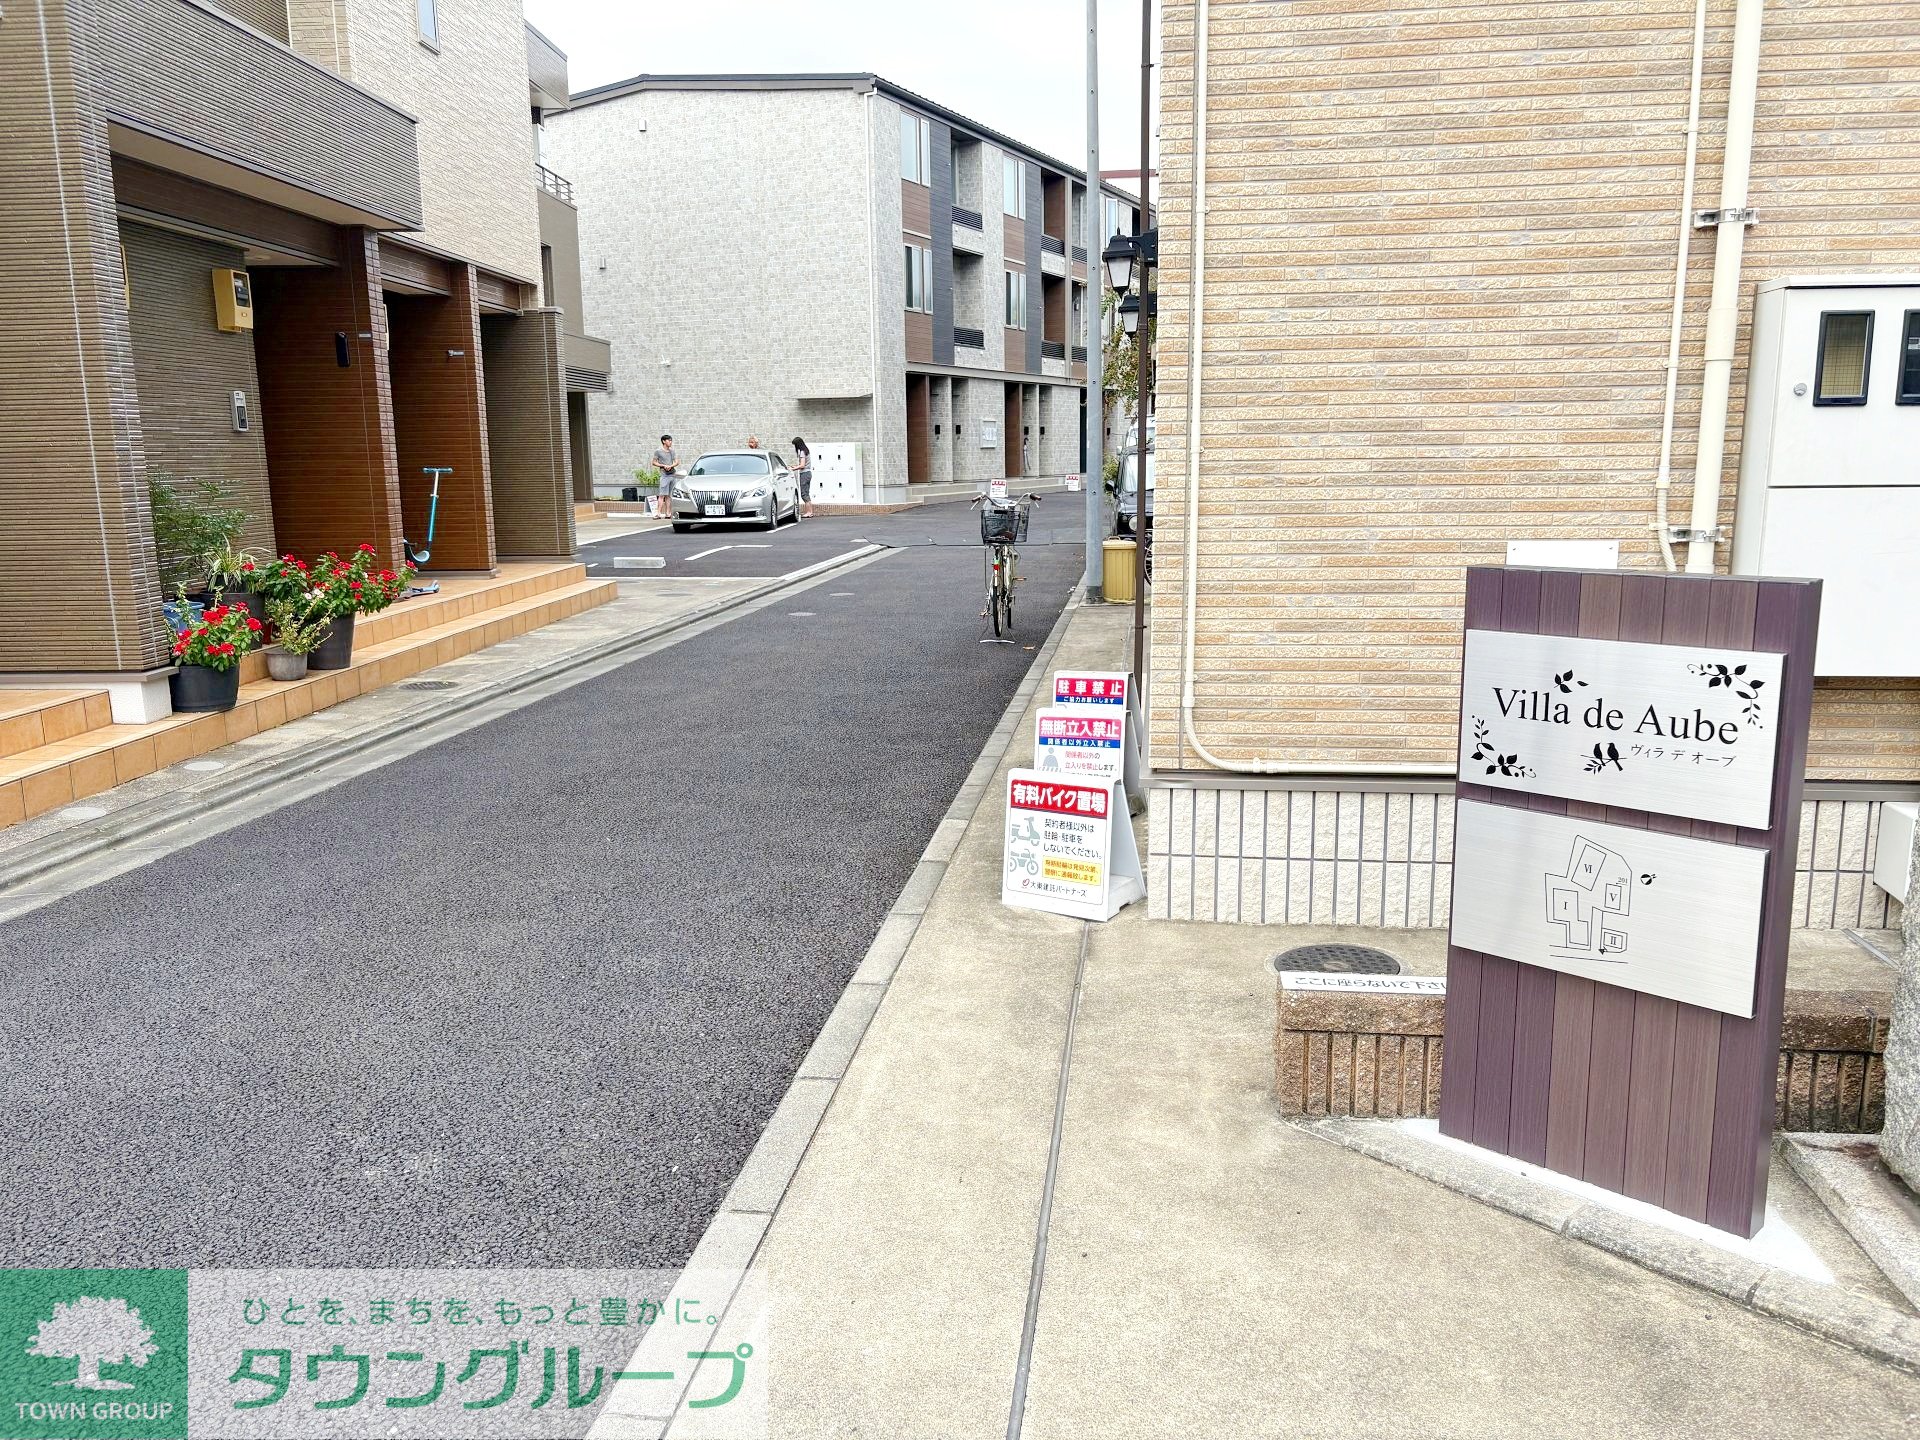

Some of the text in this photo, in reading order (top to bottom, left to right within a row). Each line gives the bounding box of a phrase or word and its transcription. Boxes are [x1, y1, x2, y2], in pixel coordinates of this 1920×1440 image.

[1057, 680, 1122, 695] 駐車禁止
[1492, 686, 1740, 746] Villa de Aube
[1041, 719, 1119, 738] 無断立入禁止
[1048, 738, 1111, 747] 関係者以外立入禁止
[1065, 751, 1101, 760] 関係者以外の
[1631, 744, 1664, 758] ヴィラ
[1671, 750, 1686, 761] デ
[1013, 784, 1106, 813] 有料バイク置場
[1044, 818, 1095, 833] 契約者様以外は
[1043, 843, 1102, 860] しないでください。
